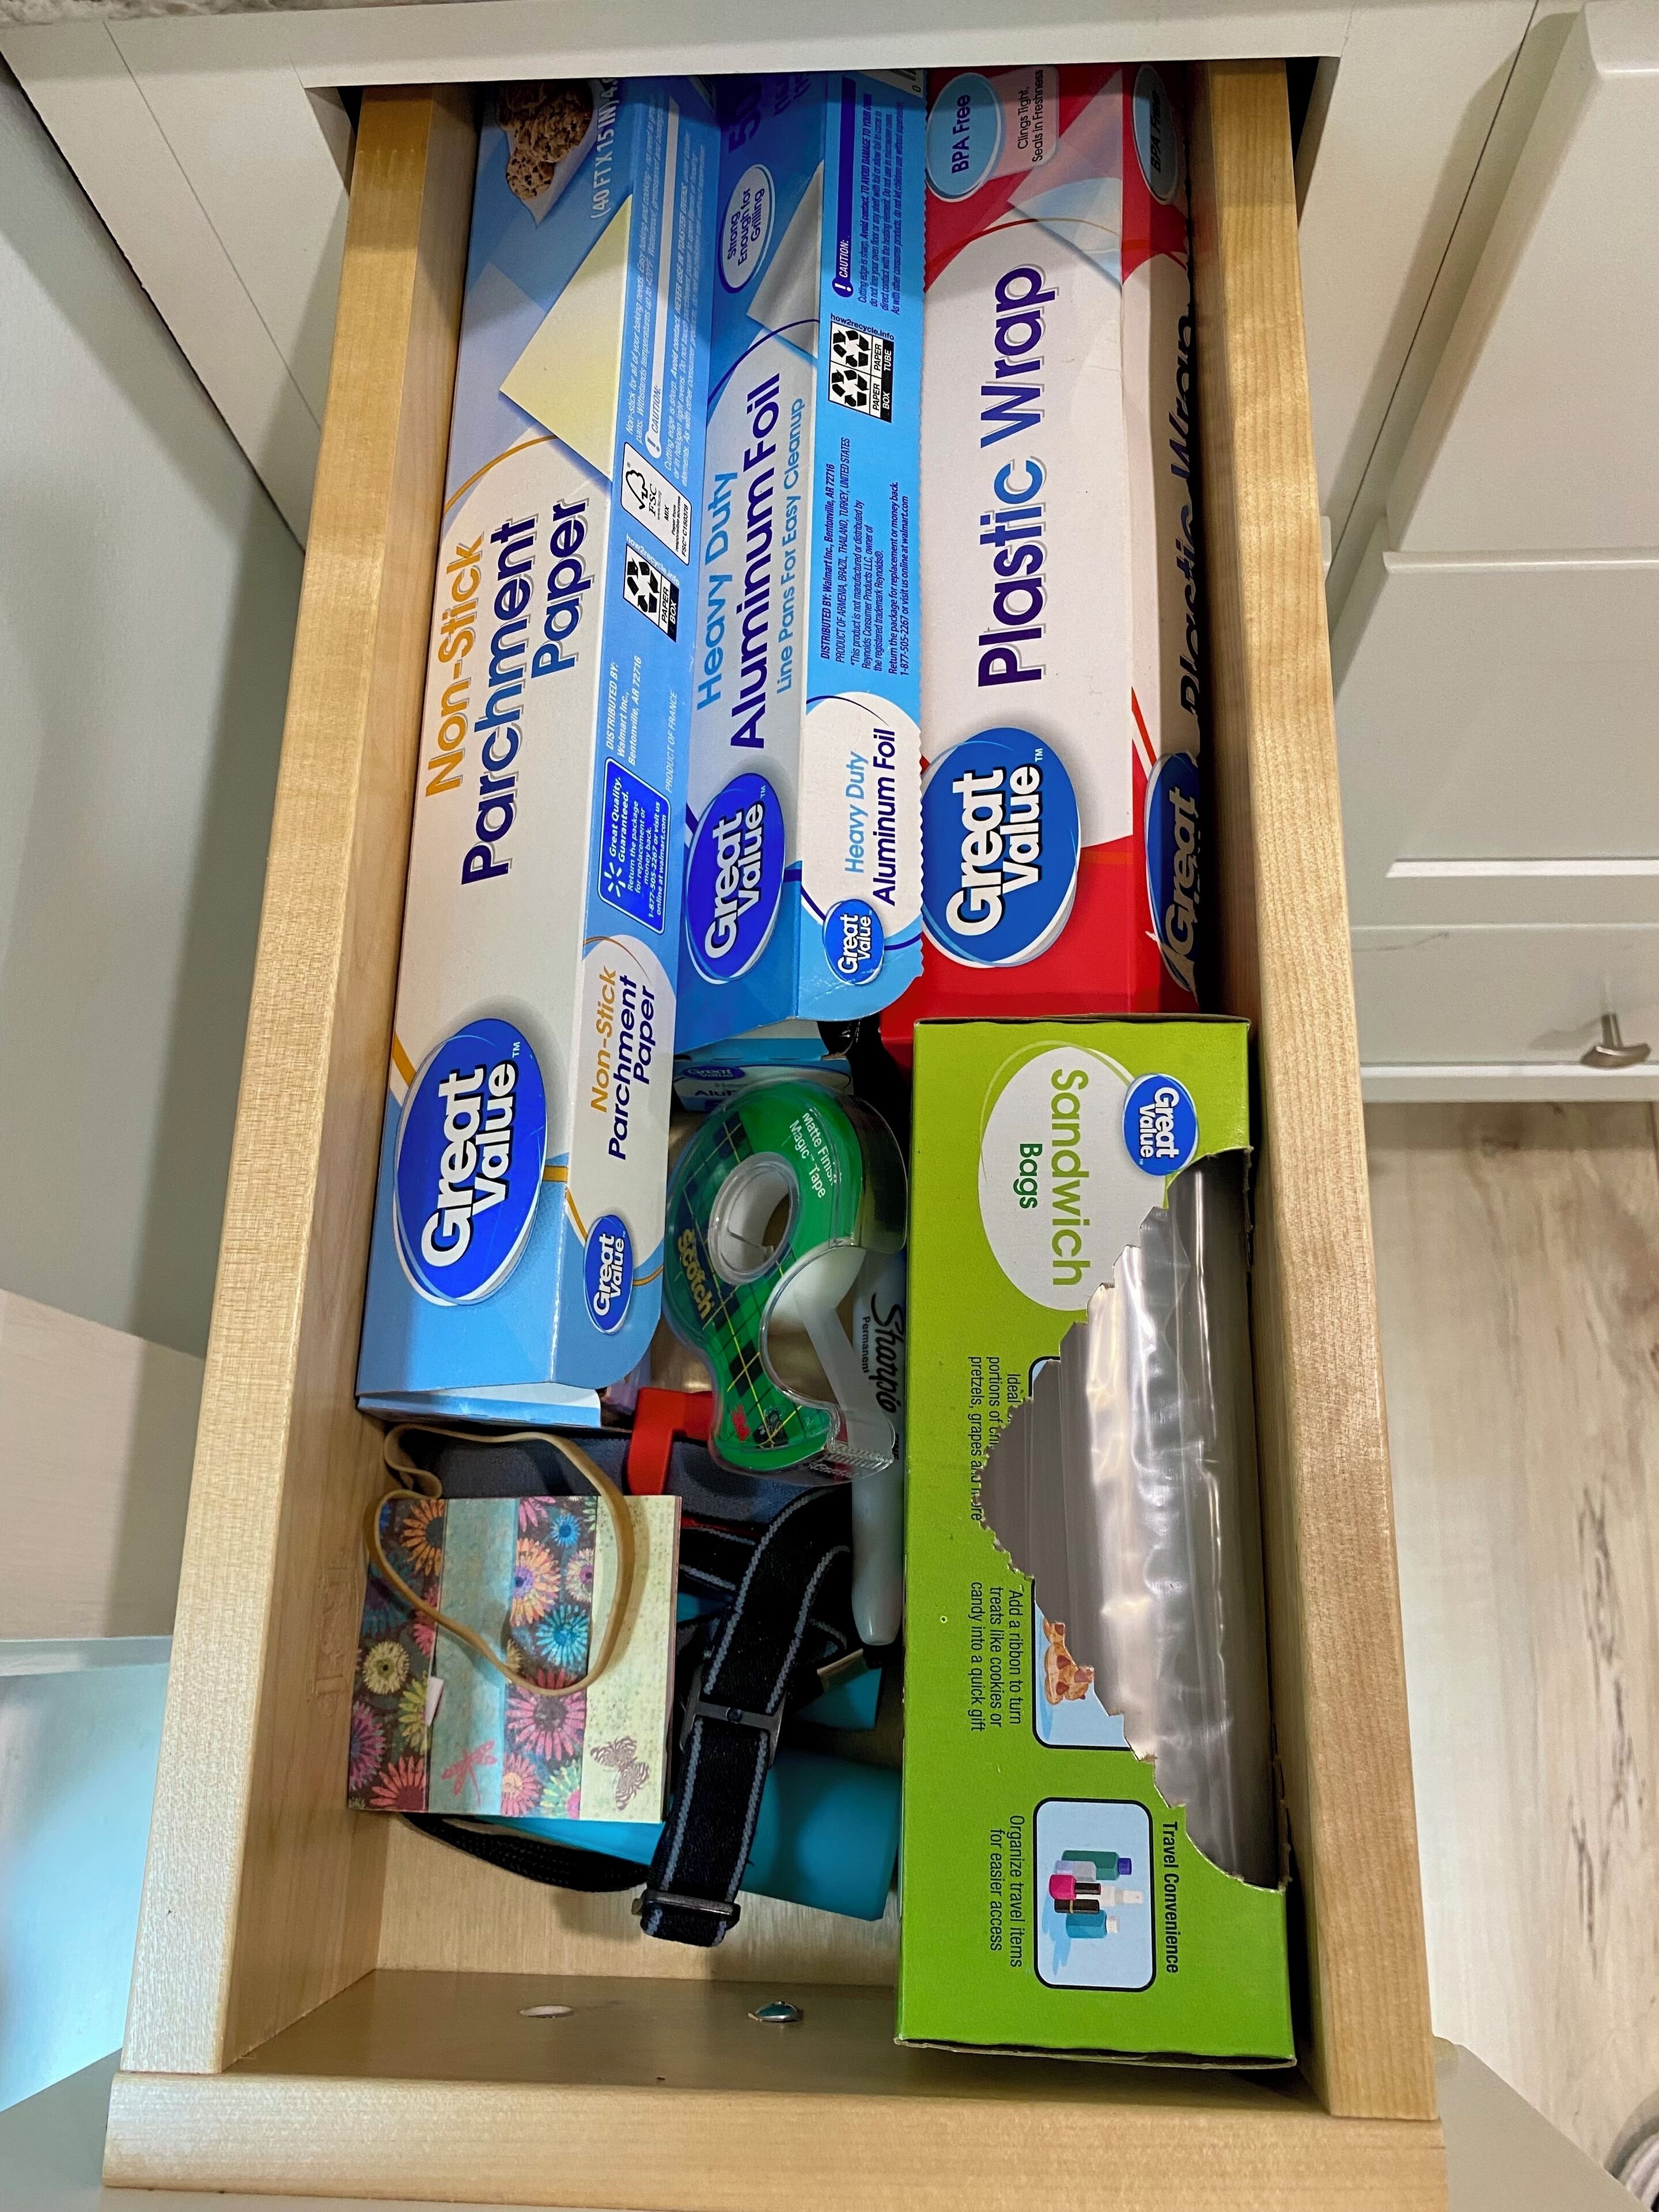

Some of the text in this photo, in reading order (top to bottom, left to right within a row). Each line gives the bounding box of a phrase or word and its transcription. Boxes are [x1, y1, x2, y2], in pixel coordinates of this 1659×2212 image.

[951, 94, 971, 173] BPA Free
[1017, 86, 1031, 149] Clings Tight,
[1032, 69, 1044, 162] Seals in Freshness
[1150, 90, 1161, 173] BPA Free
[591, 100, 619, 218] (40 FT X 15 IN)
[727, 213, 741, 260] Strong
[738, 188, 752, 266] Enough for
[751, 188, 765, 241] Grilling
[839, 239, 850, 278] CAUTION:
[872, 382, 881, 411] PAPER
[873, 343, 882, 371] PAPER
[883, 349, 892, 371] TUBE
[650, 385, 662, 434] CAUTION:
[882, 391, 891, 410] BOX
[648, 484, 657, 517] FSC
[978, 267, 1055, 687] Plastic Wrap
[730, 373, 780, 749] Aluminum Foil
[777, 398, 805, 694] Line Pans For Easy Cleanup
[821, 463, 836, 659] DISTRIBUTED BY: Walmart Inc., Bentonville, AR 72716
[835, 437, 850, 663] PRODUCT OF ARMENIA, BRAZIL, THAILAND, TURKEY, UNITED STATES
[900, 496, 909, 675] 1-877-505-2267 or visit us online at walmart.com
[531, 499, 591, 679] Paper
[661, 587, 669, 624] PAPER
[669, 601, 677, 624] BOX
[697, 472, 737, 710] Heavy Duty
[426, 535, 482, 797] Non-Stick
[461, 518, 535, 885] Parchment
[606, 661, 619, 750] DISTRIBUTED BY:
[617, 692, 630, 757] Walmart Inc.,
[627, 655, 642, 766] Bentonville, AR 72716
[665, 689, 678, 793] PRODUCT OF FRANCE
[609, 777, 622, 857] Great Quality.
[618, 791, 629, 863] Guaranteed.
[630, 801, 639, 841] package
[640, 807, 645, 819] or
[653, 834, 658, 845] or
[655, 801, 661, 813] us
[658, 814, 667, 873] walmart.com
[844, 751, 868, 873] Heavy Duty
[873, 729, 896, 906] Aluminum Foil
[1002, 766, 1040, 895] Value
[636, 821, 645, 878] replacement
[649, 846, 657, 918] 1-877-505-2267
[658, 874, 664, 885] at
[704, 812, 744, 959] Great
[738, 804, 763, 915] Value
[946, 770, 1004, 936] Great
[1165, 786, 1198, 956] Great
[837, 915, 858, 974] Great
[856, 916, 872, 960] Value
[591, 966, 616, 1112] Non-Stick
[609, 975, 637, 1160] Parchment
[634, 986, 655, 1085] Paper
[472, 1063, 516, 1215] Value
[789, 1119, 826, 1198] Magic Tape
[802, 1112, 822, 1147] Matte
[1139, 1103, 1157, 1157] Value
[1155, 1086, 1180, 1158] Great
[421, 1069, 484, 1267] Great
[1013, 1142, 1042, 1209] Bags
[1051, 1069, 1090, 1286] Sandwich
[593, 1233, 614, 1316] Great
[609, 1238, 625, 1298] Value
[677, 1228, 713, 1320] Scotch
[861, 1316, 872, 1373] Permanent
[869, 1292, 906, 1414] Sharpie
[986, 1357, 1003, 1407] portions
[968, 1357, 985, 1456] pretzels, grapes
[989, 1410, 1003, 1423] of
[1007, 1374, 1021, 1403] Ideal
[967, 1581, 986, 1732] candy into a quick gift
[988, 1586, 1005, 1727] treats like cookies or
[1008, 1590, 1024, 1724] Add a ribbon to turn
[990, 1828, 1005, 1952] for easier access
[1007, 1815, 1025, 1968] Organize travel items
[1162, 1821, 1180, 1974] Travel Convenience
